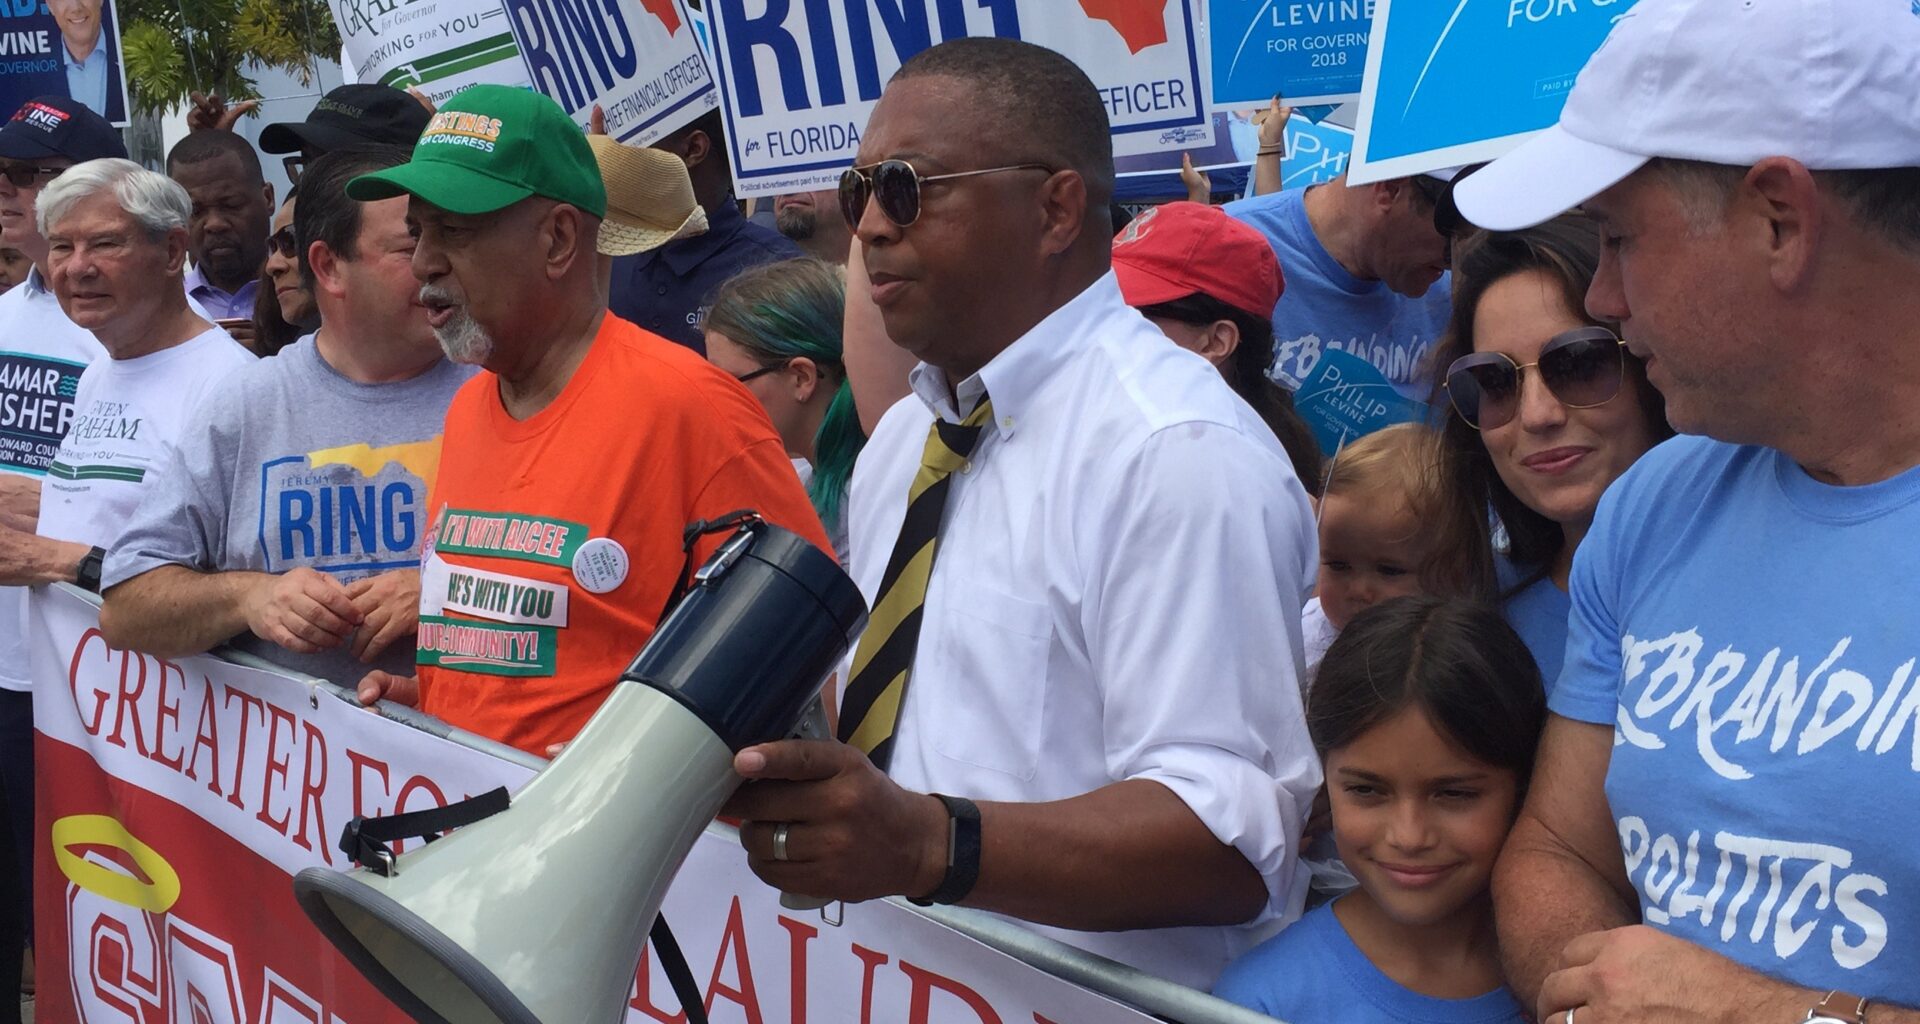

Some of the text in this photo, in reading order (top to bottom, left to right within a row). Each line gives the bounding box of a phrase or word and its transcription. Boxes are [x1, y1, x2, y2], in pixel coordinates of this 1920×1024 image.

[394, 3, 437, 26] Governor
[1272, 0, 1375, 27] LEVINE
[366, 13, 480, 73] WORKING FOR YOU
[508, 0, 637, 115] RING
[1266, 33, 1371, 53] FOR GOVERN
[1311, 52, 1347, 67] 2018
[603, 53, 706, 133] HIEF FINANCIAL OFFICER
[1542, 82, 1561, 92] PAID
[431, 133, 496, 153] CONGRESS
[744, 122, 861, 158] for FLORIDA
[1319, 364, 1387, 418] PHILIP
[1323, 393, 1367, 425] LEVINE
[279, 481, 416, 561] RING
[502, 518, 570, 559] ALCEE
[448, 572, 555, 620] HE'S WITH YOU
[69, 627, 333, 867] GREATER
[1618, 815, 1889, 970] POLITICS
